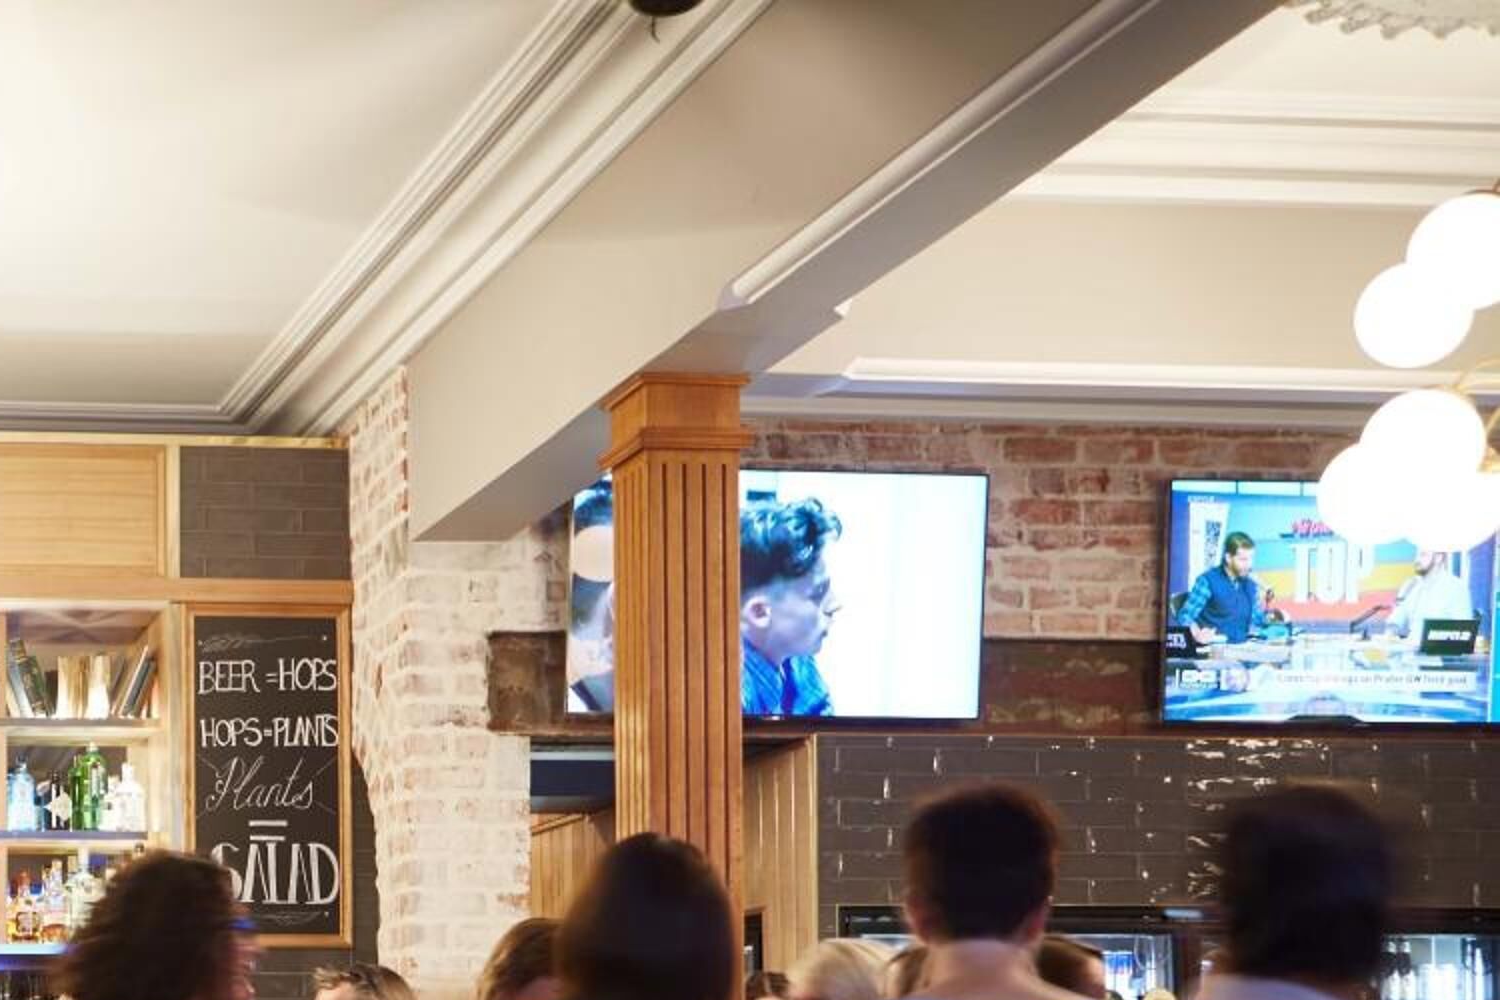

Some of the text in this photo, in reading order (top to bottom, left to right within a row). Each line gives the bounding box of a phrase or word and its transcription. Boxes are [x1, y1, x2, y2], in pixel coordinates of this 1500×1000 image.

[198, 659, 260, 694] BEER
[278, 657, 337, 690] HOPS
[200, 717, 263, 748] HOPS
[272, 713, 338, 747] PLANTS
[205, 755, 313, 811] Plants
[211, 842, 340, 905] SALAD
